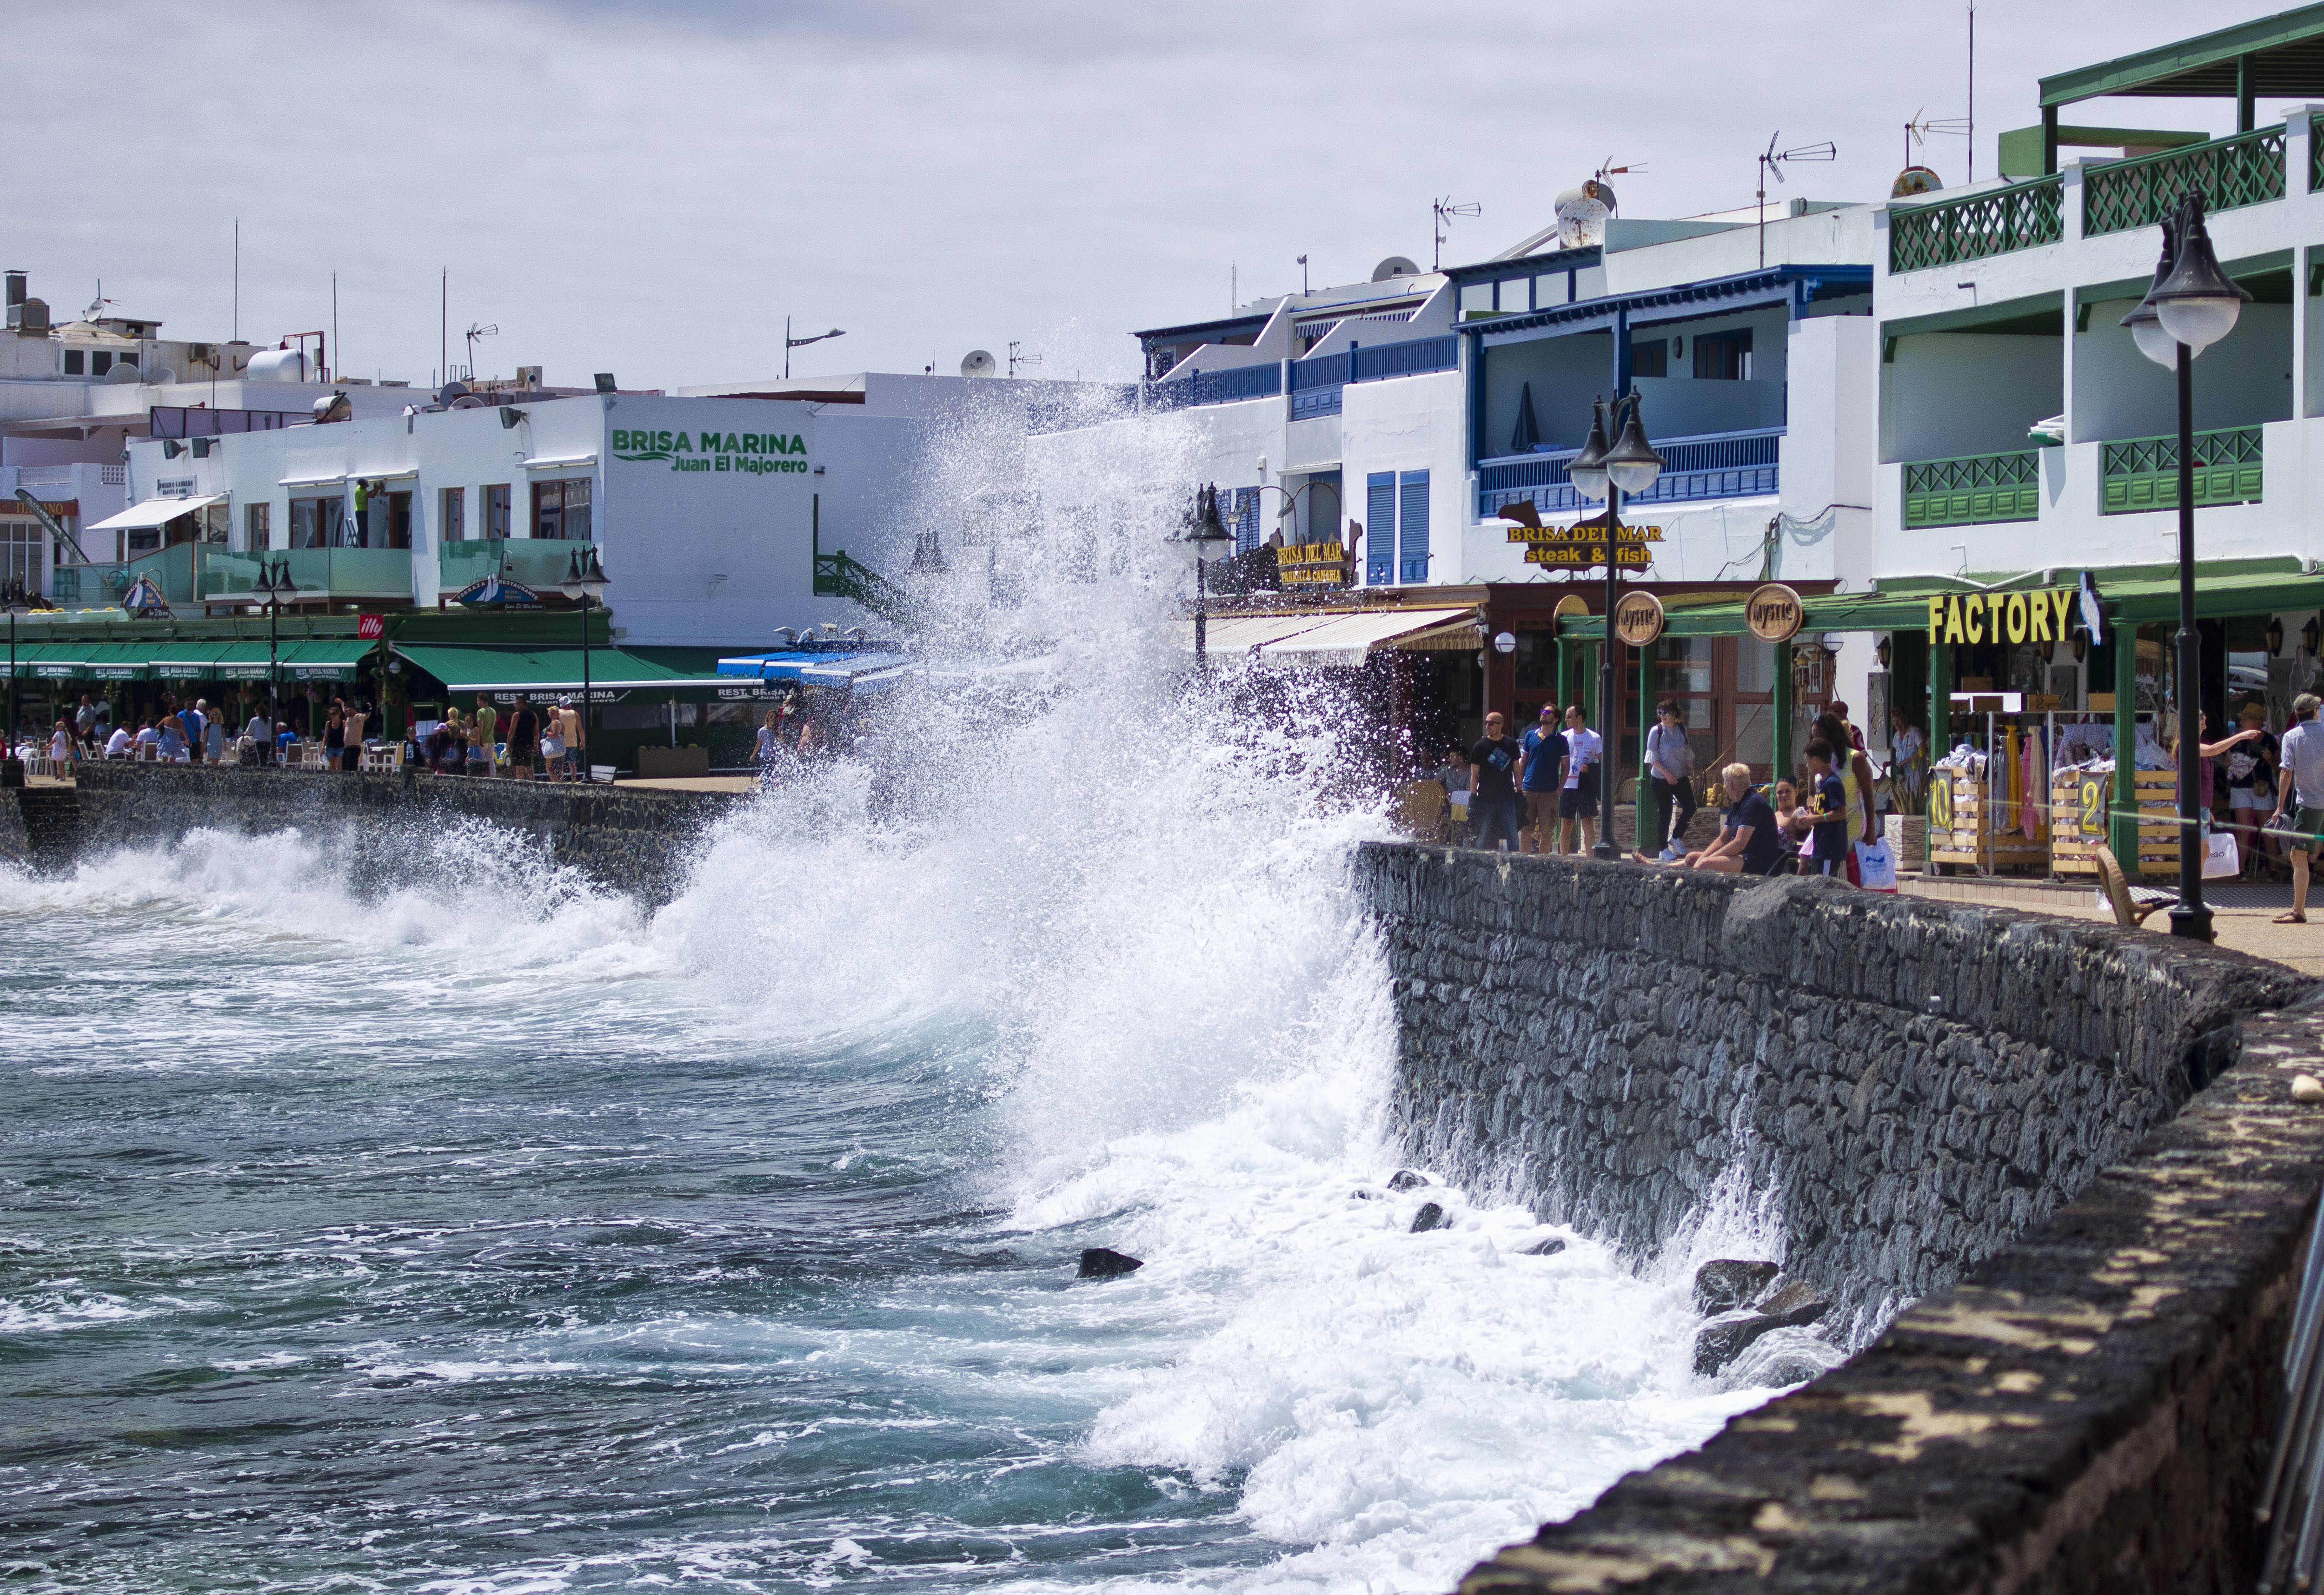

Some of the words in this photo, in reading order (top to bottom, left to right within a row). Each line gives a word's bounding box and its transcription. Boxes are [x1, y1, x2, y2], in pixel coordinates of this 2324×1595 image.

[612, 430, 693, 452] BRISA
[701, 432, 807, 455] MARINA
[671, 456, 710, 471] Juan
[715, 456, 730, 471] El
[735, 456, 808, 476] Majorero
[1508, 526, 1569, 541] BRISA
[1617, 526, 1665, 541] MAR
[1277, 545, 1303, 566] BRISA
[1305, 544, 1321, 563] DEL
[1323, 543, 1343, 561] MAR
[1526, 546, 1581, 562] steak
[1591, 547, 1606, 563] &
[1617, 547, 1651, 562] fish
[457, 582, 485, 599] TERRAZA
[498, 580, 538, 601] RESTAURANTE
[1929, 590, 2072, 644] FACTORY
[361, 618, 382, 637] illy
